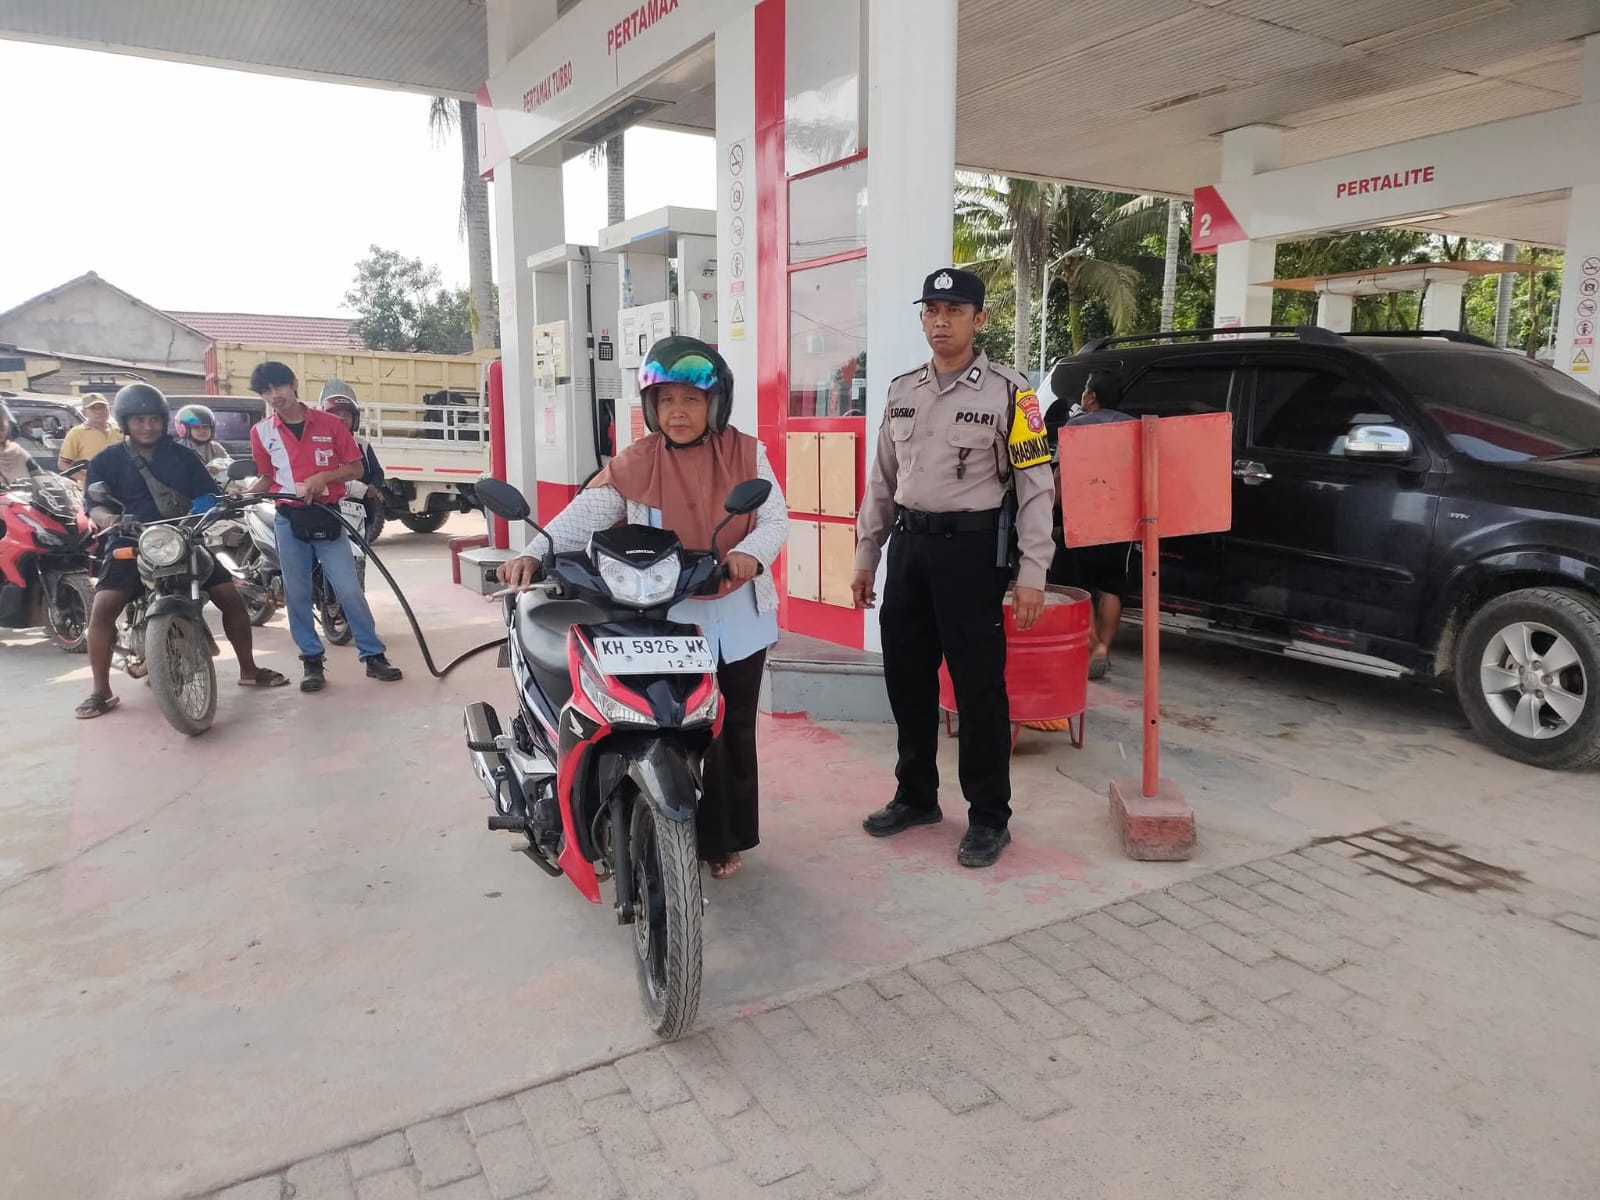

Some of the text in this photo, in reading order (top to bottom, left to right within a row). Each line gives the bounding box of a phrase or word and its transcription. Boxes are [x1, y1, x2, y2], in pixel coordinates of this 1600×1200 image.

[523, 60, 573, 113] PERTAMAX TURBO
[1336, 165, 1435, 199] PERTALITE
[1199, 213, 1212, 238] 2
[955, 411, 995, 426] POLRI
[601, 639, 708, 655] KH 5926 WK
